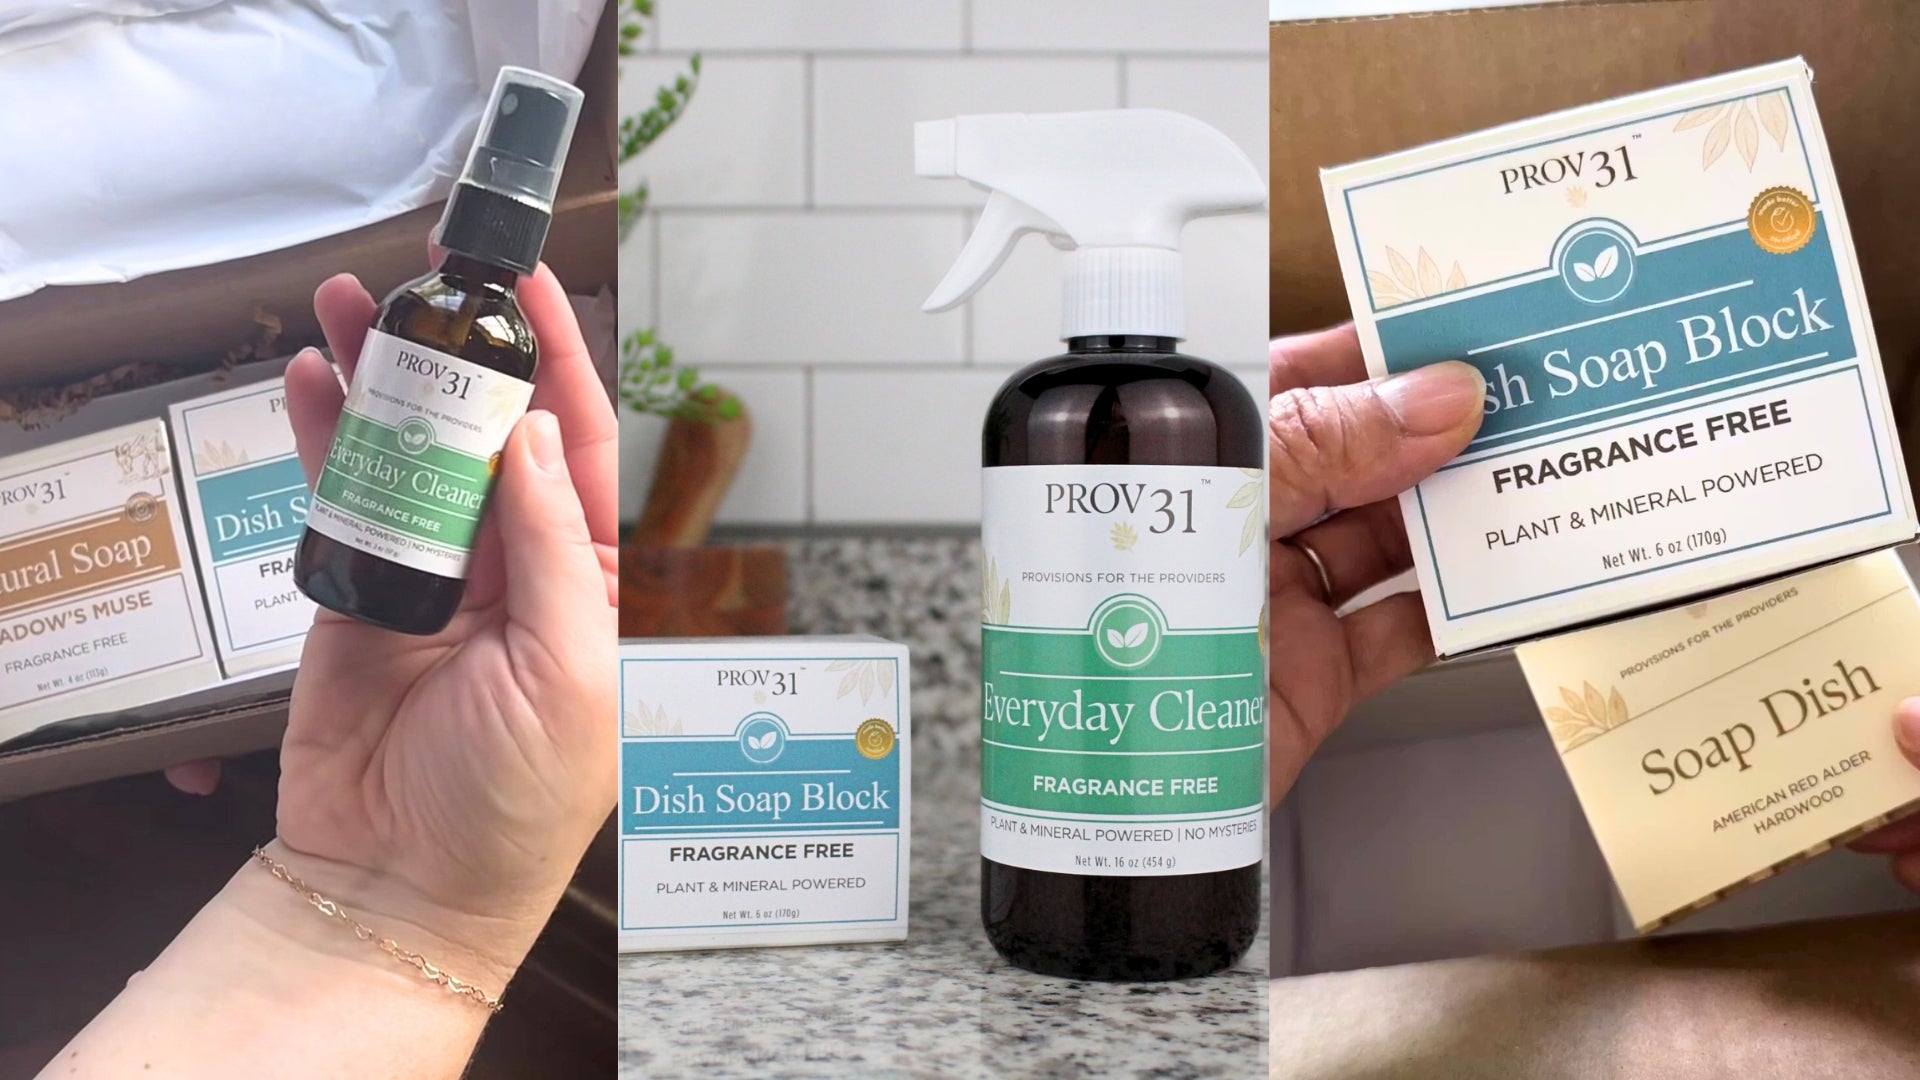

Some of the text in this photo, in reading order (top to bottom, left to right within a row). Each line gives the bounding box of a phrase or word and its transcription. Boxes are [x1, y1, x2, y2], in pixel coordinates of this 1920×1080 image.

[1500, 151, 1586, 195] PROV
[1590, 145, 1638, 189] 31
[1483, 287, 1834, 414] sh Soap Block
[396, 351, 472, 400] PROV 31
[406, 401, 424, 412] FOR
[425, 408, 440, 419] THE
[440, 414, 482, 433] PROVIDERS
[1492, 400, 1792, 494] FRAGRANCE FREE
[0, 479, 67, 506] ROV 31
[329, 437, 486, 511] Everyday Cleaner
[214, 500, 283, 542] Dish
[341, 489, 442, 533] FRAGRANCE FREE
[1045, 483, 1148, 514] PROV
[1149, 489, 1197, 534] 31
[1486, 453, 1824, 550] PLANT & MINERAL POWERED
[333, 513, 363, 532] MINERAL
[365, 526, 407, 547] POWERED
[412, 543, 425, 552] NO
[1603, 528, 1728, 570] Net Wt. 6 oz (170g)
[0, 535, 152, 594] ural Soap
[1022, 572, 1226, 584] PROVISIONS FOR THE PROVIDERS
[0, 590, 153, 645] ADOW'S MUSE
[254, 590, 298, 611] PLANT
[5, 632, 128, 674] FRAGRANCE FREE
[1620, 587, 1799, 680] PROVISIONS FOR THE PROVIDERS
[37, 682, 51, 692] Net
[717, 670, 798, 695] PROV 31
[984, 682, 1264, 745] Everyday Cleaner
[1641, 659, 1882, 796] Soap Dish
[632, 781, 890, 820] Dish Soap Block
[1033, 775, 1218, 797] FRAGRANCE FREE
[1711, 749, 1873, 833] AMERICAN RED ALDER
[990, 816, 1018, 835] PLANT
[1020, 822, 1028, 835] &
[1030, 824, 1091, 842] MINERAL
[1095, 829, 1174, 842] POWERED
[1185, 826, 1206, 841] NO
[1209, 819, 1257, 840] MYSTERIES
[1754, 784, 1845, 834] HARDWOOD
[669, 843, 854, 862] FRAGRANCE FREE
[1075, 855, 1091, 867] Net
[1094, 855, 1112, 867] Wt.
[1114, 855, 1125, 868] 16
[1128, 858, 1139, 868] oz
[657, 877, 866, 894] PLANT & MINERAL POWERED
[723, 908, 800, 919] Net Wt. 6 oz (170g)
